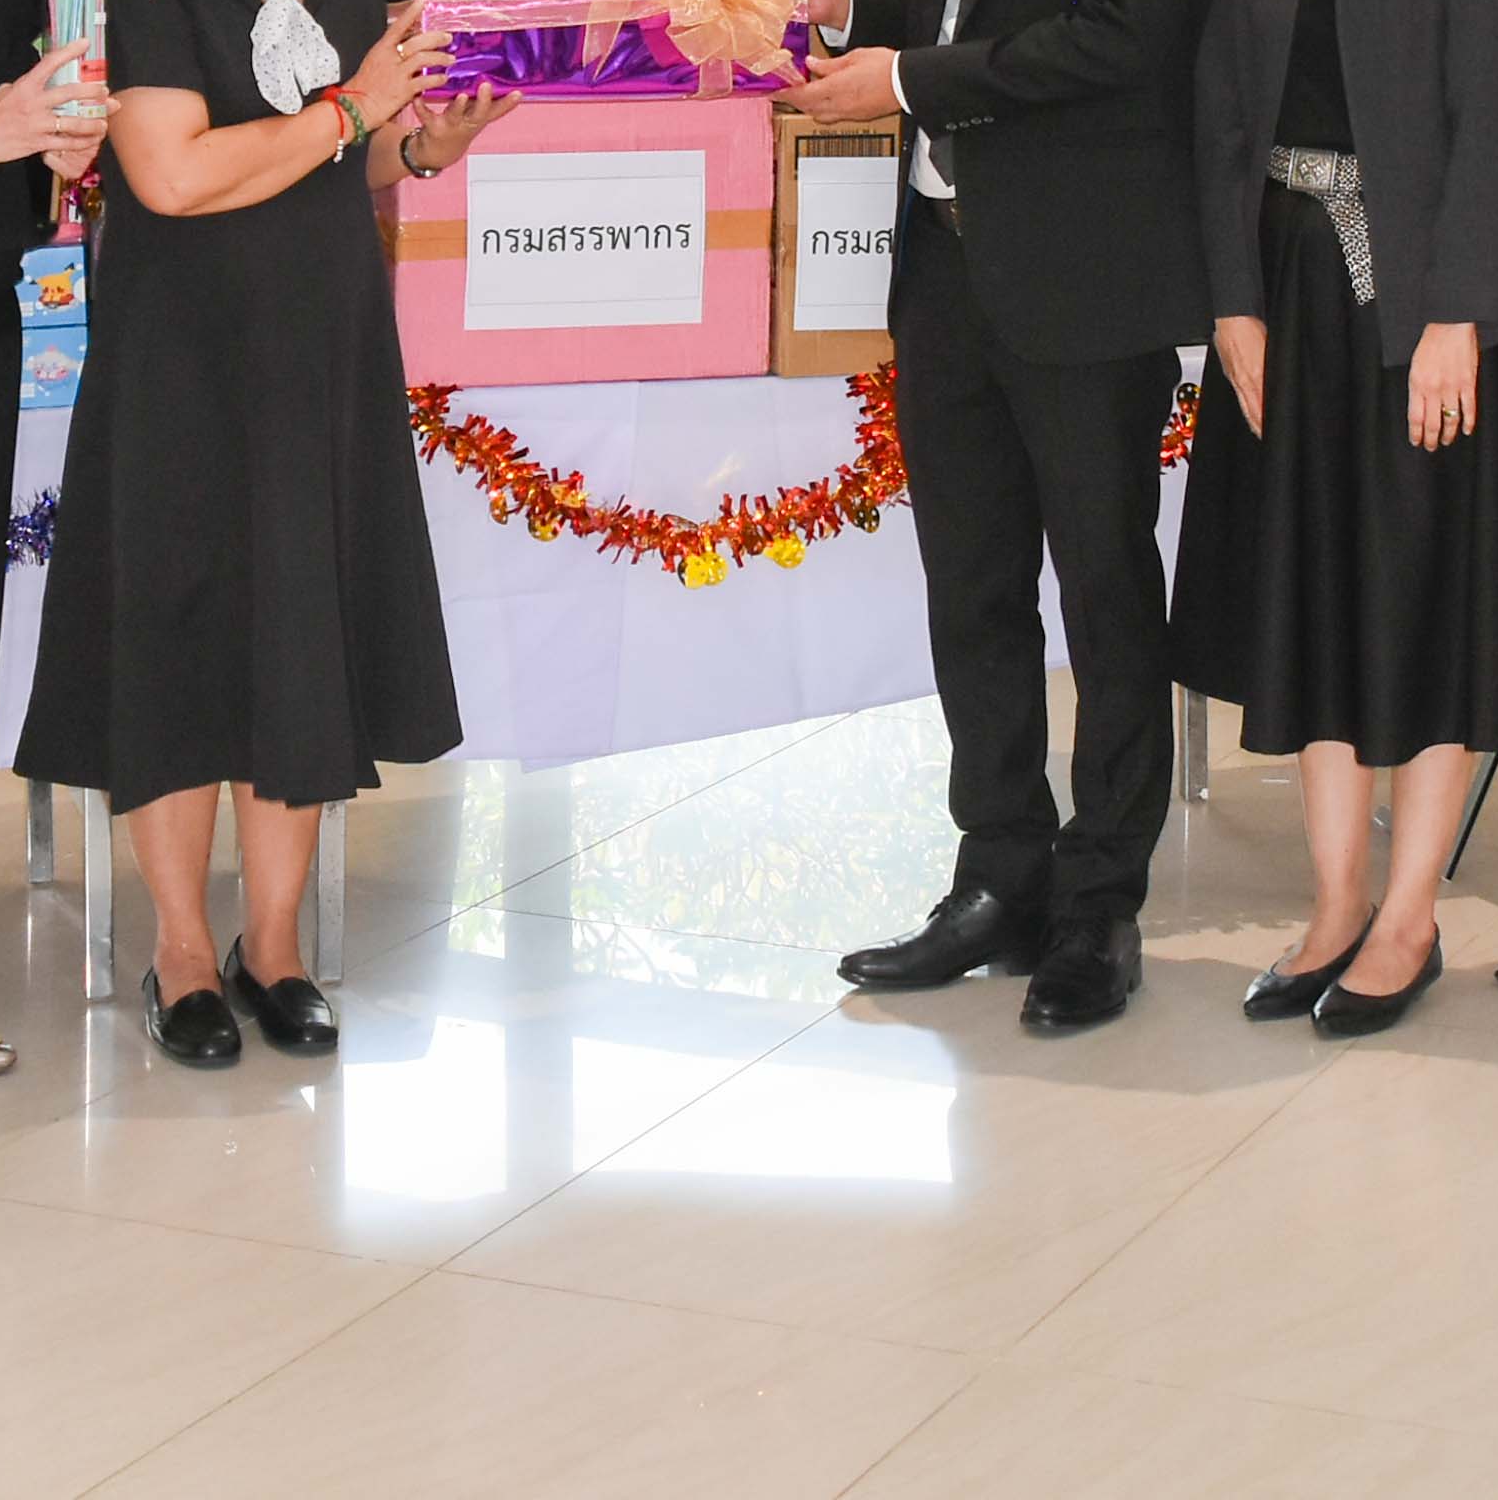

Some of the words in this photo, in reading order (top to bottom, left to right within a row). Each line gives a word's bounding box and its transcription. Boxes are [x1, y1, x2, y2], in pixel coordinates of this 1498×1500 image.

[481, 223, 692, 254] กรมสรรพากร
[812, 227, 894, 255] กรมส
